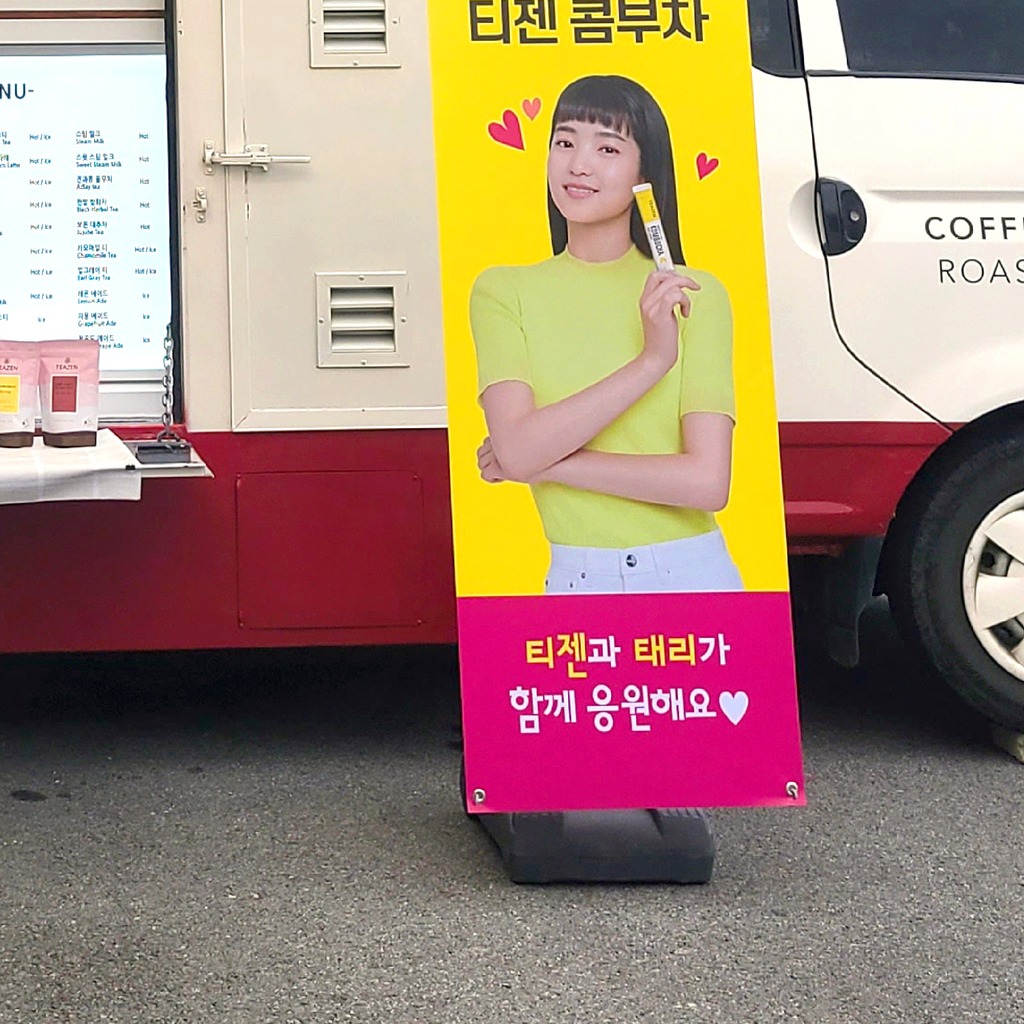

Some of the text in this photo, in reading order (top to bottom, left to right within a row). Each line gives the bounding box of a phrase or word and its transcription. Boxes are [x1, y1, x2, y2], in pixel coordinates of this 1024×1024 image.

[924, 216, 1024, 241] COFF
[525, 632, 730, 679] 티젠과 태리가
[509, 684, 717, 734] 함께 응원해요
